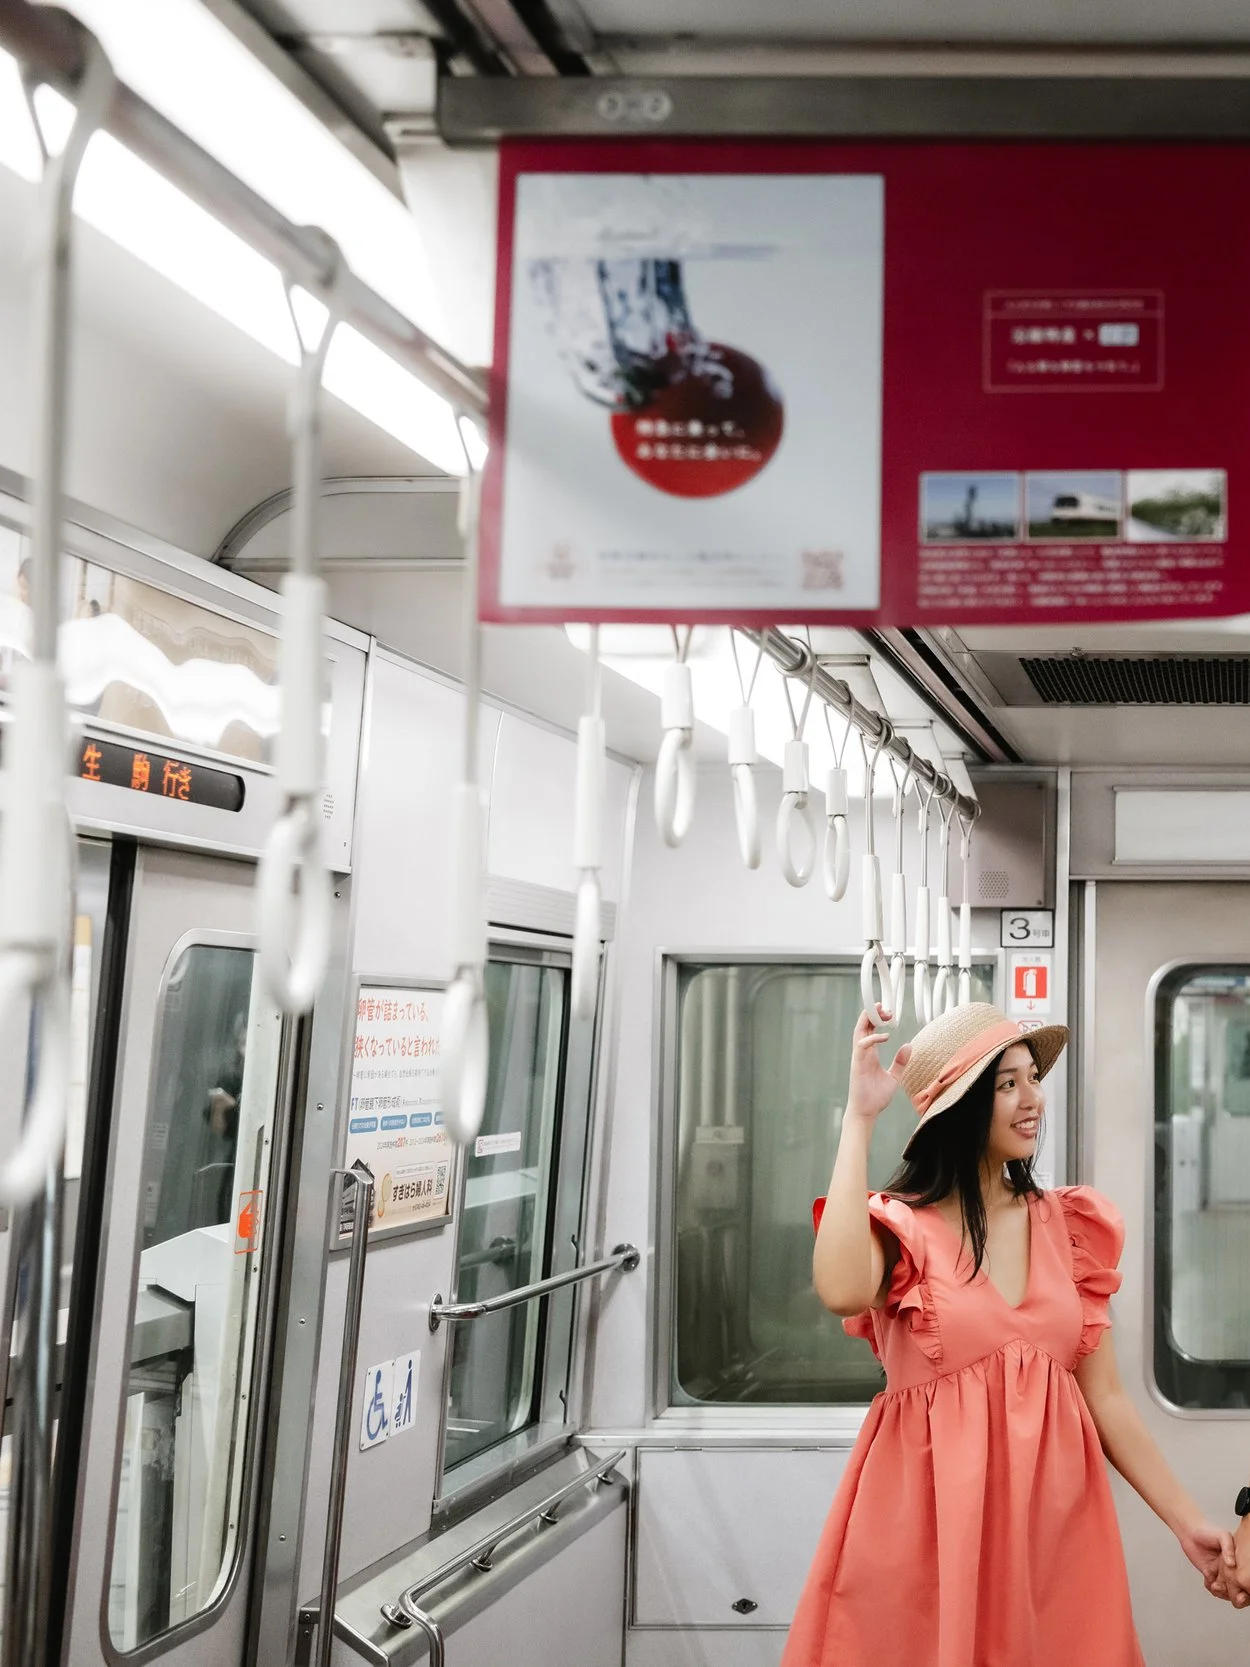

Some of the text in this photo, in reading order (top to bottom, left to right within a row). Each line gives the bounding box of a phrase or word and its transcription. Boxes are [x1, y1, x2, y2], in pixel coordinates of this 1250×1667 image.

[1009, 917, 1031, 940] 3
[392, 1179, 433, 1202] すぎはら婦人科
